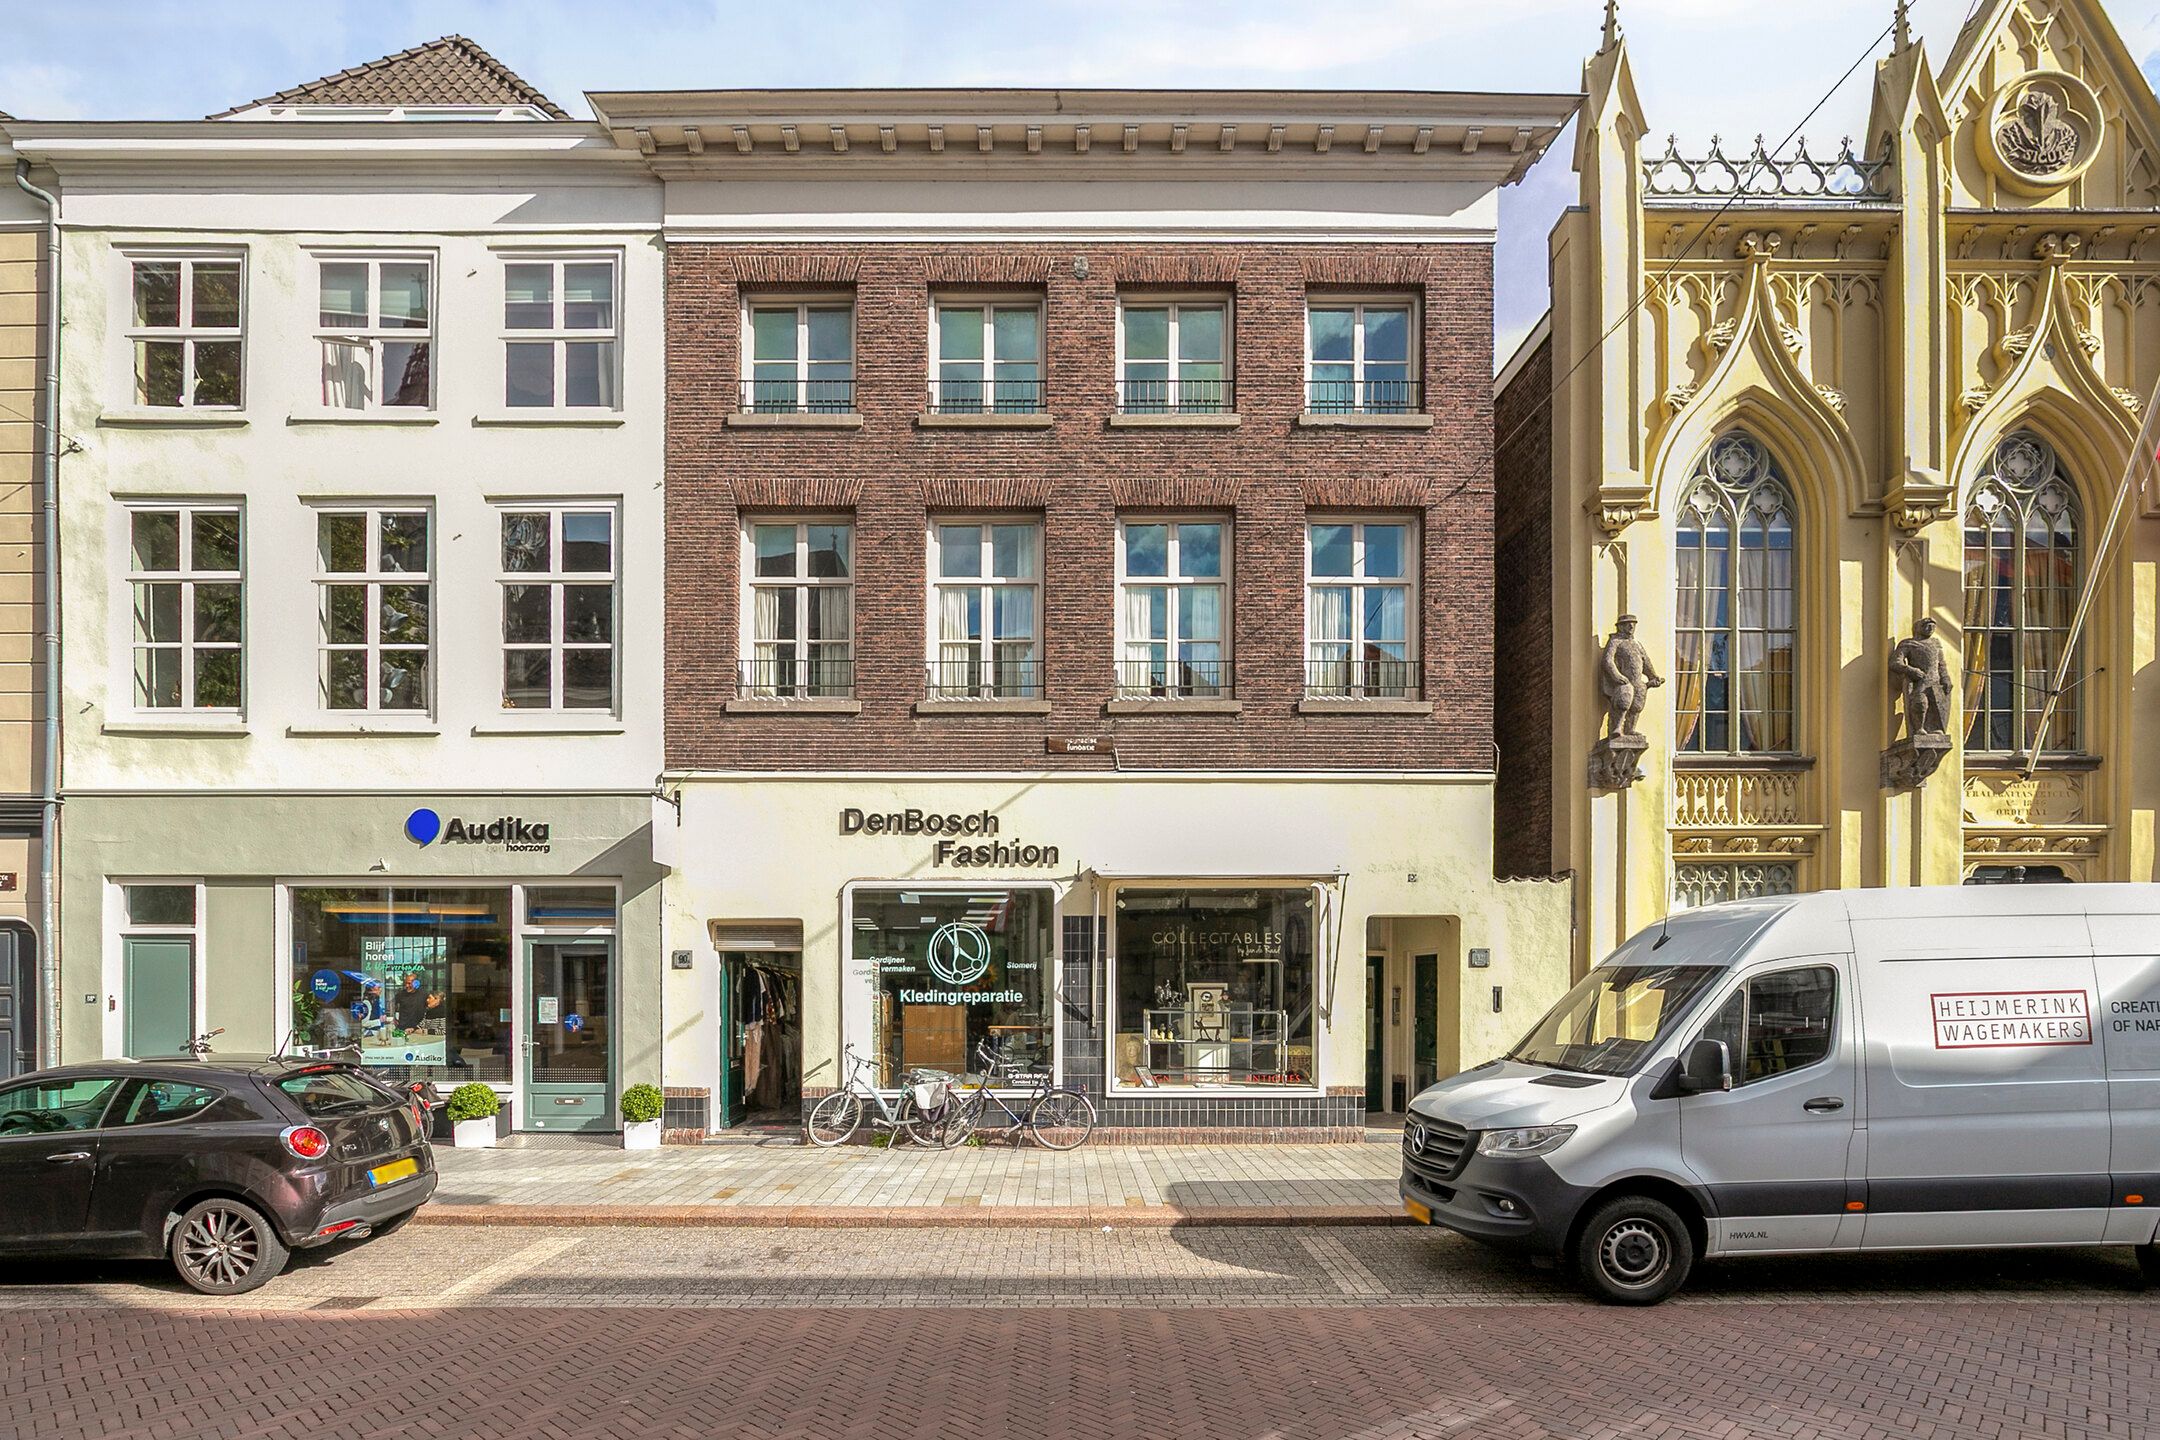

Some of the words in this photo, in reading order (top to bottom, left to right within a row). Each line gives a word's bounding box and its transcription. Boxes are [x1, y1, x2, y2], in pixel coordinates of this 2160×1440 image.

[843, 808, 999, 834] DenBosch
[444, 816, 549, 841] Audika
[506, 844, 550, 854] hoorzorg
[938, 838, 1059, 864] Fashion
[1152, 932, 1282, 944] COLLECTABLES
[365, 941, 385, 951] Blijf
[365, 952, 394, 961] horen
[869, 956, 906, 965] Gordijnen
[881, 965, 916, 973] vermaken
[1007, 961, 1037, 970] Stomerij
[900, 990, 1023, 1005] Kledingreparatie
[1940, 998, 2082, 1017] HEIJMERINK
[1943, 1021, 2083, 1041] WAGEMAKERS
[2113, 1019, 2130, 1032] OF
[1729, 1231, 1768, 1239] HWVA.NL
